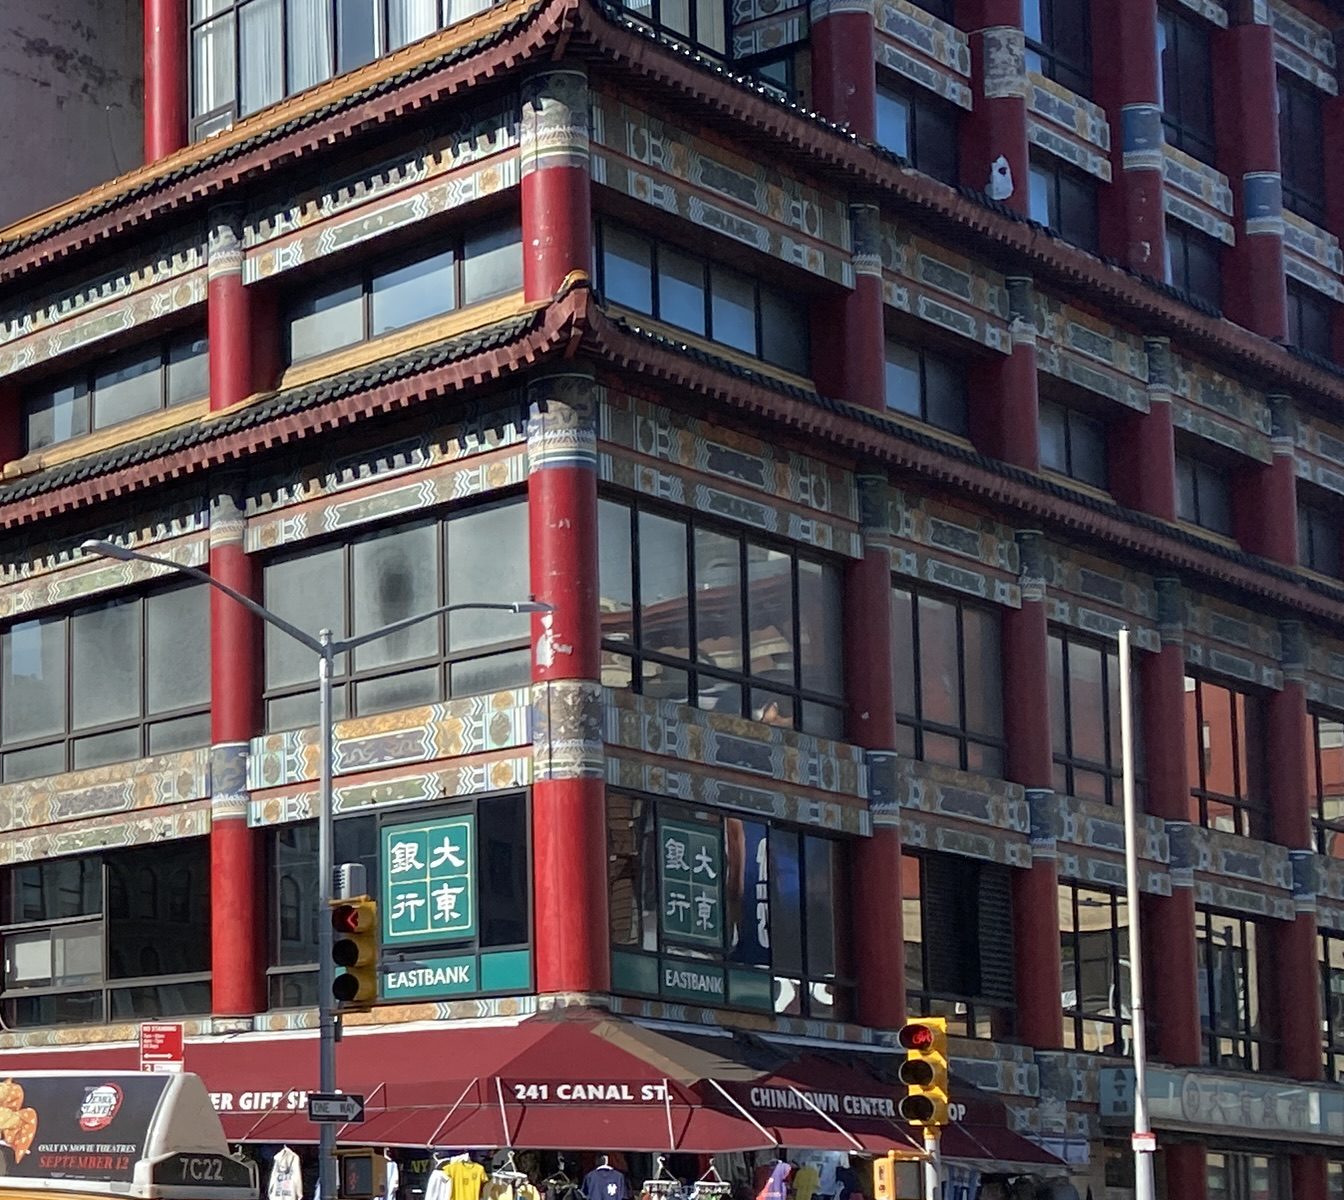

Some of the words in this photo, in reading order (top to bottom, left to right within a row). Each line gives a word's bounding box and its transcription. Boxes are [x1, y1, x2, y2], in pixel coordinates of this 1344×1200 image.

[387, 965, 470, 989] EASTBANK
[665, 969, 723, 994] EASTBANK
[209, 1093, 233, 1110] ER
[239, 1091, 283, 1110] GIFT
[514, 1084, 548, 1100] 241
[556, 1084, 634, 1100] CANAL
[314, 1102, 330, 1113] ONE
[340, 1103, 355, 1115] WAY
[750, 1087, 839, 1114] CHINATOWN
[843, 1095, 895, 1117] CENTER
[948, 1104, 966, 1121] OP
[38, 1144, 59, 1152] ONLY
[69, 1144, 95, 1152] MOVIE
[96, 1144, 136, 1153] THEATRES
[40, 1155, 112, 1169] SEPTEMBER
[116, 1156, 129, 1169] 12
[179, 1158, 223, 1182] 7C22
